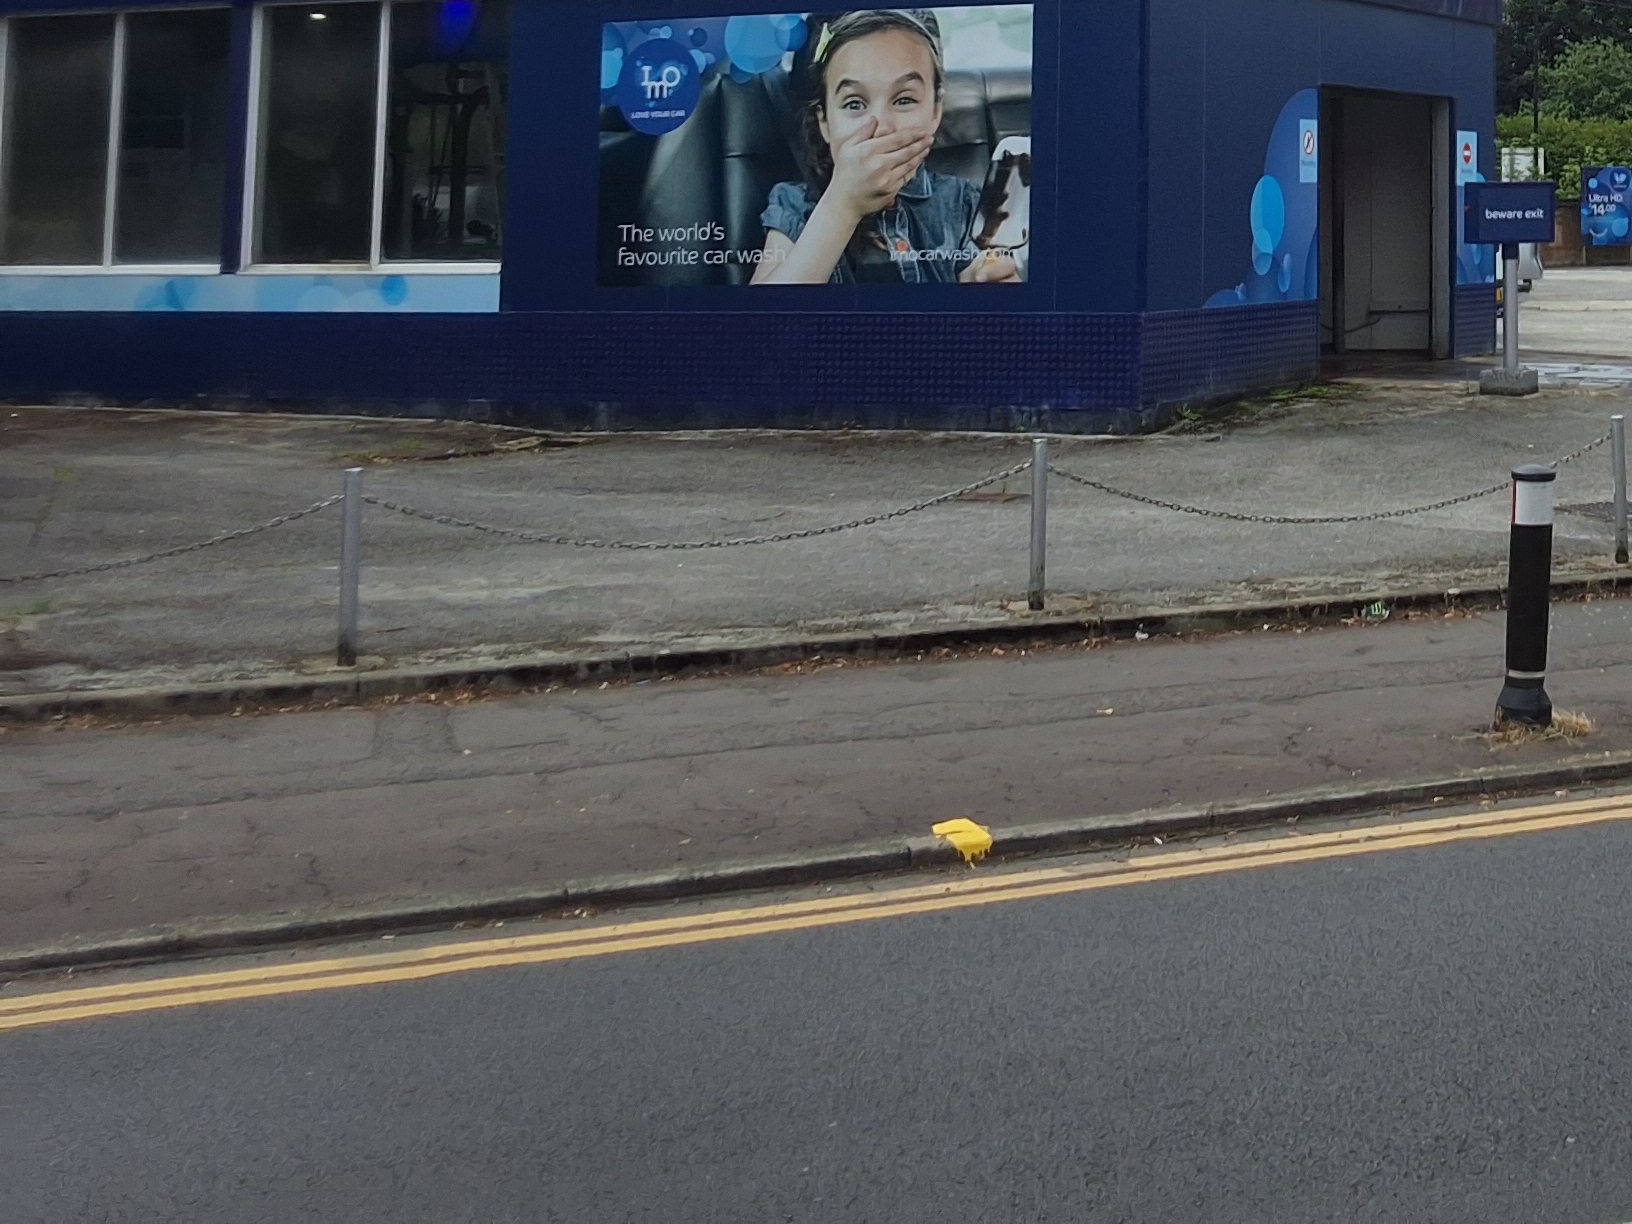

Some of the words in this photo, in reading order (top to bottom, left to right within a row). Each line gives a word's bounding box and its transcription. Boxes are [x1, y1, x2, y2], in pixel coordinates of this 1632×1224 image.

[1588, 193, 1609, 203] Ultra
[1610, 193, 1623, 203] HD
[1485, 208, 1523, 220] beware
[1525, 207, 1544, 219] exit
[618, 223, 654, 242] The
[658, 221, 725, 242] world's
[617, 246, 699, 266] favourite
[703, 248, 734, 265] car
[736, 245, 786, 264] wash
